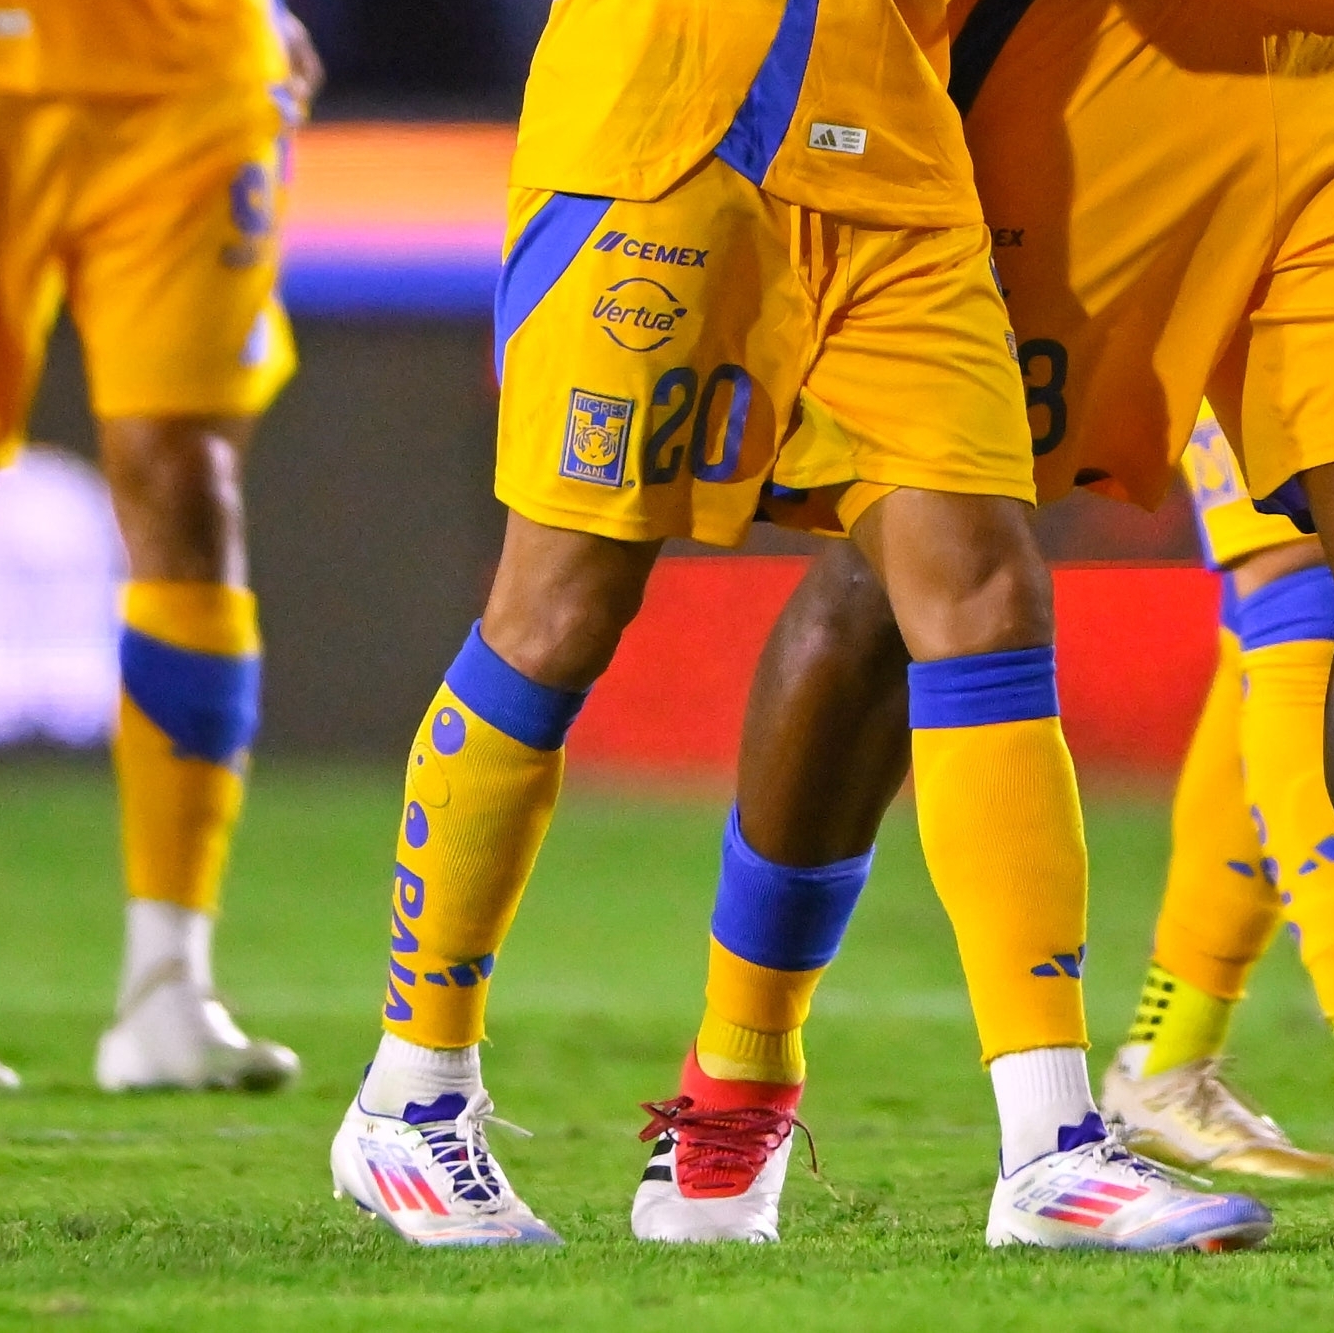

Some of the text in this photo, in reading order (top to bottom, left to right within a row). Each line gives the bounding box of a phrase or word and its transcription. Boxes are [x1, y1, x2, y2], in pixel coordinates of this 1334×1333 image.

[623, 239, 709, 267] CEMEX
[593, 296, 675, 331] Vertua
[577, 397, 627, 418] TIGRES
[644, 364, 752, 484] 20
[575, 462, 607, 478] UANL
